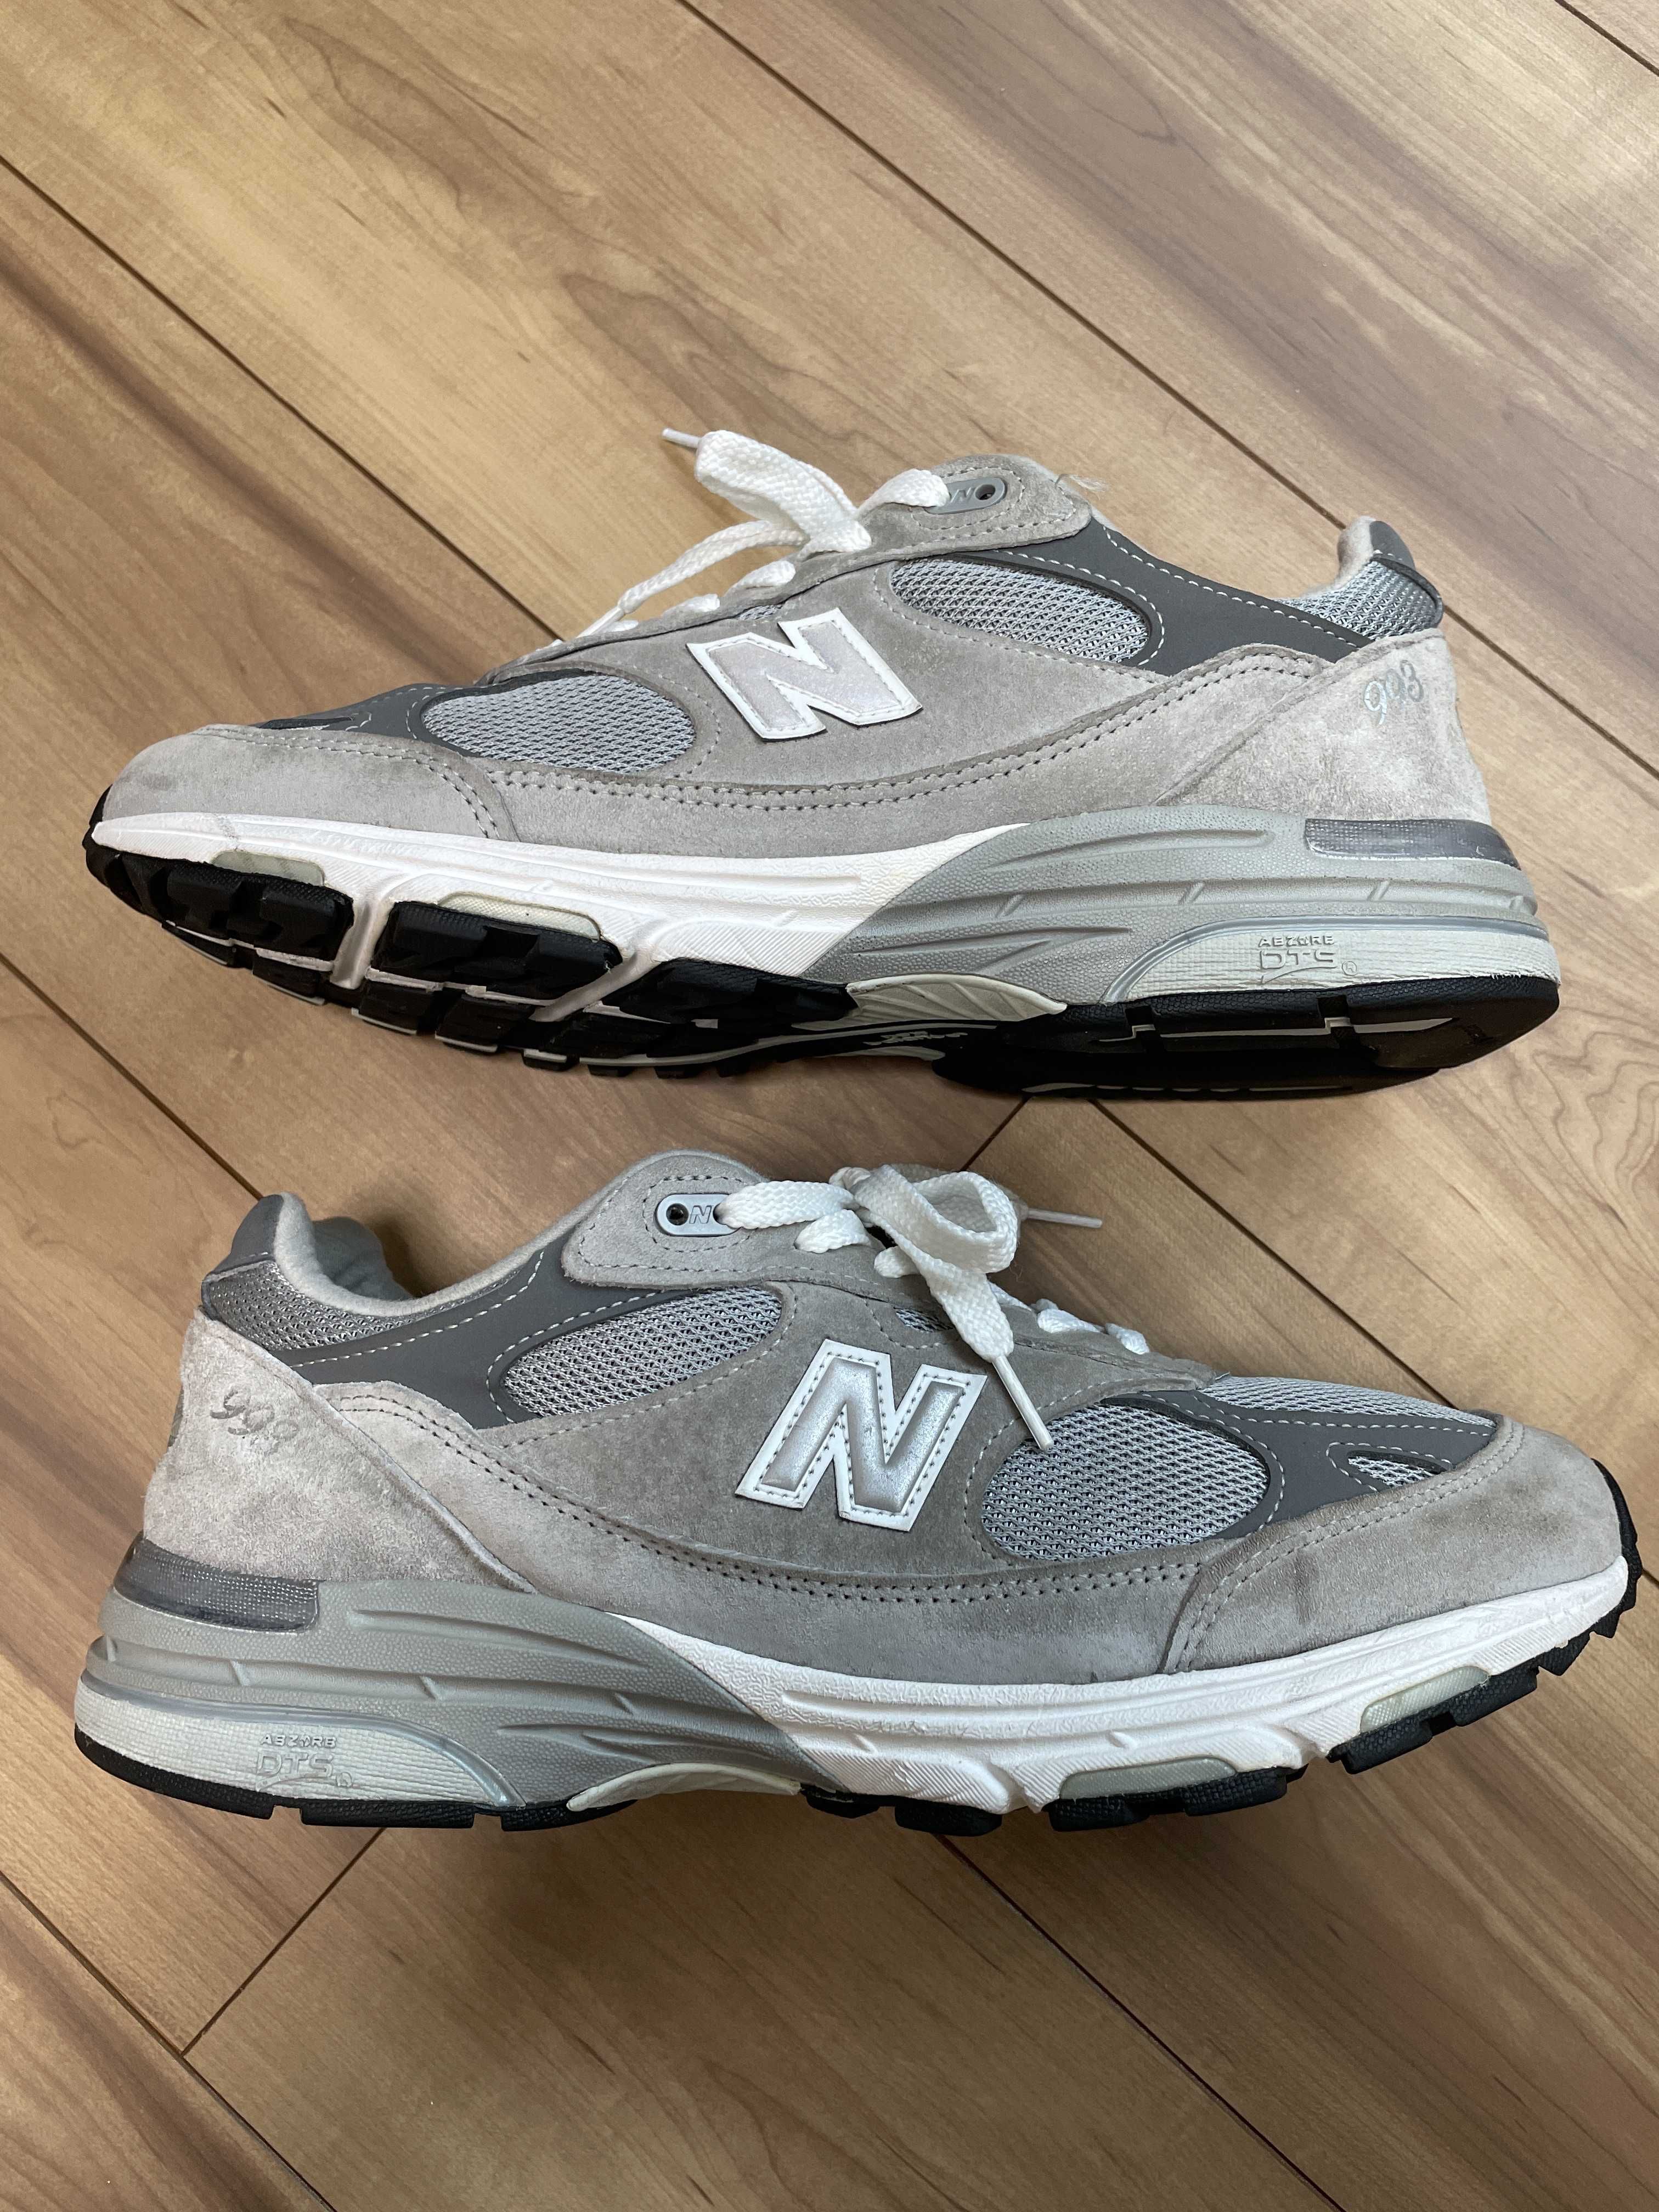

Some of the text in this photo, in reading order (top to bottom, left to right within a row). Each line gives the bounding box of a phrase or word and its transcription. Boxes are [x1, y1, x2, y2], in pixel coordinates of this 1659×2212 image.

[686, 608, 923, 741] N
[689, 1205, 714, 1224] N
[735, 1339, 988, 1532] N
[256, 1751, 334, 1778] DTS
